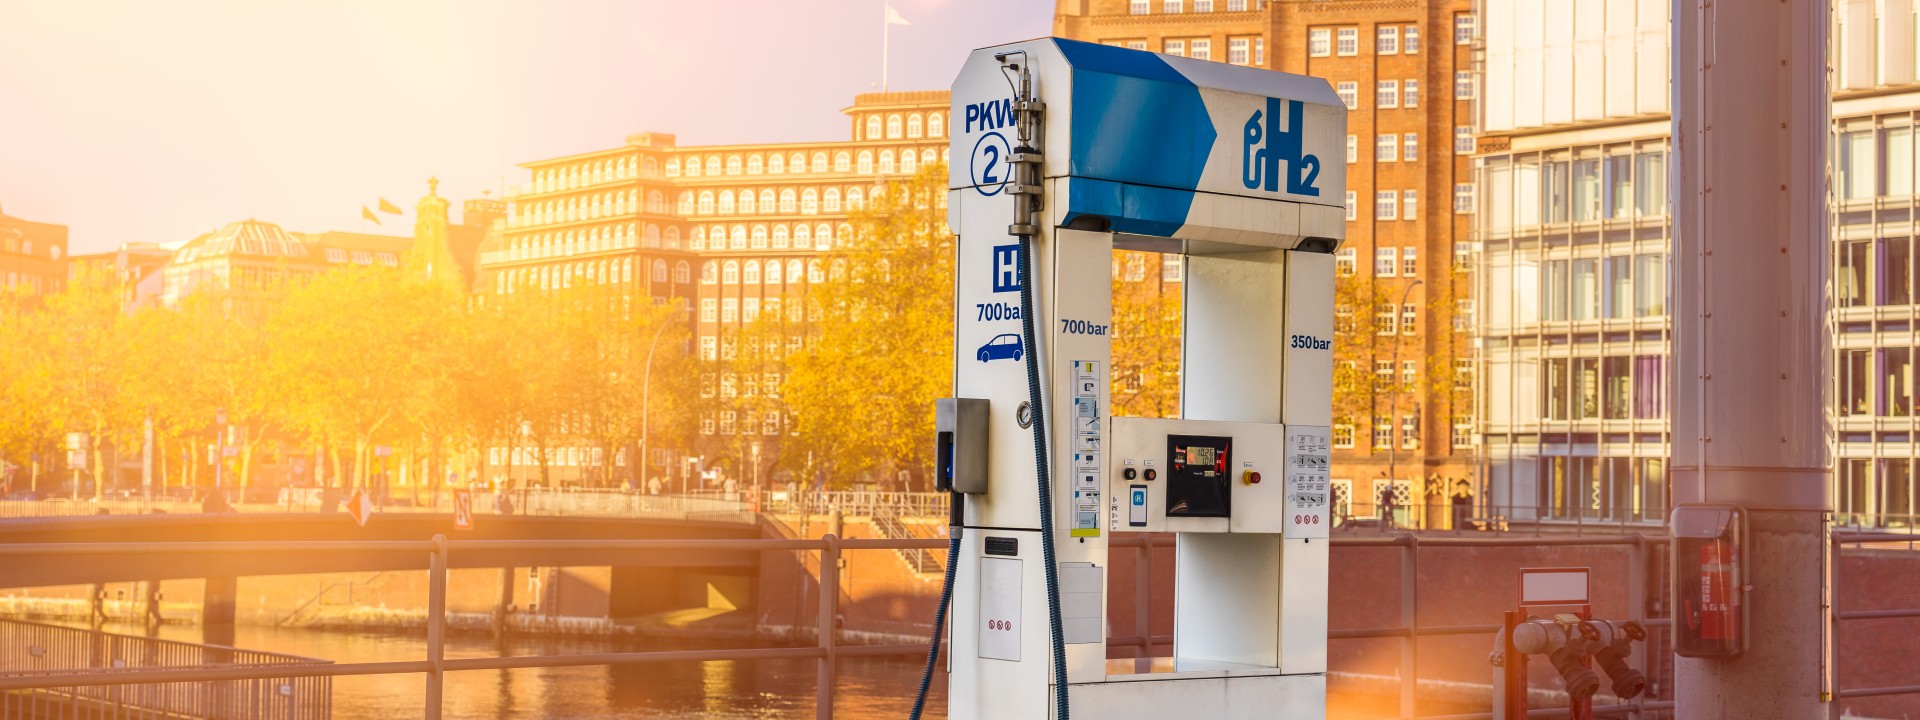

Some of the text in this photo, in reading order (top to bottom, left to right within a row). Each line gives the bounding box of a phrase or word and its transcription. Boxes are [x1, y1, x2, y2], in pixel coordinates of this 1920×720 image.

[965, 98, 1018, 133] PKW
[983, 144, 999, 184] 2
[998, 249, 1021, 288] H
